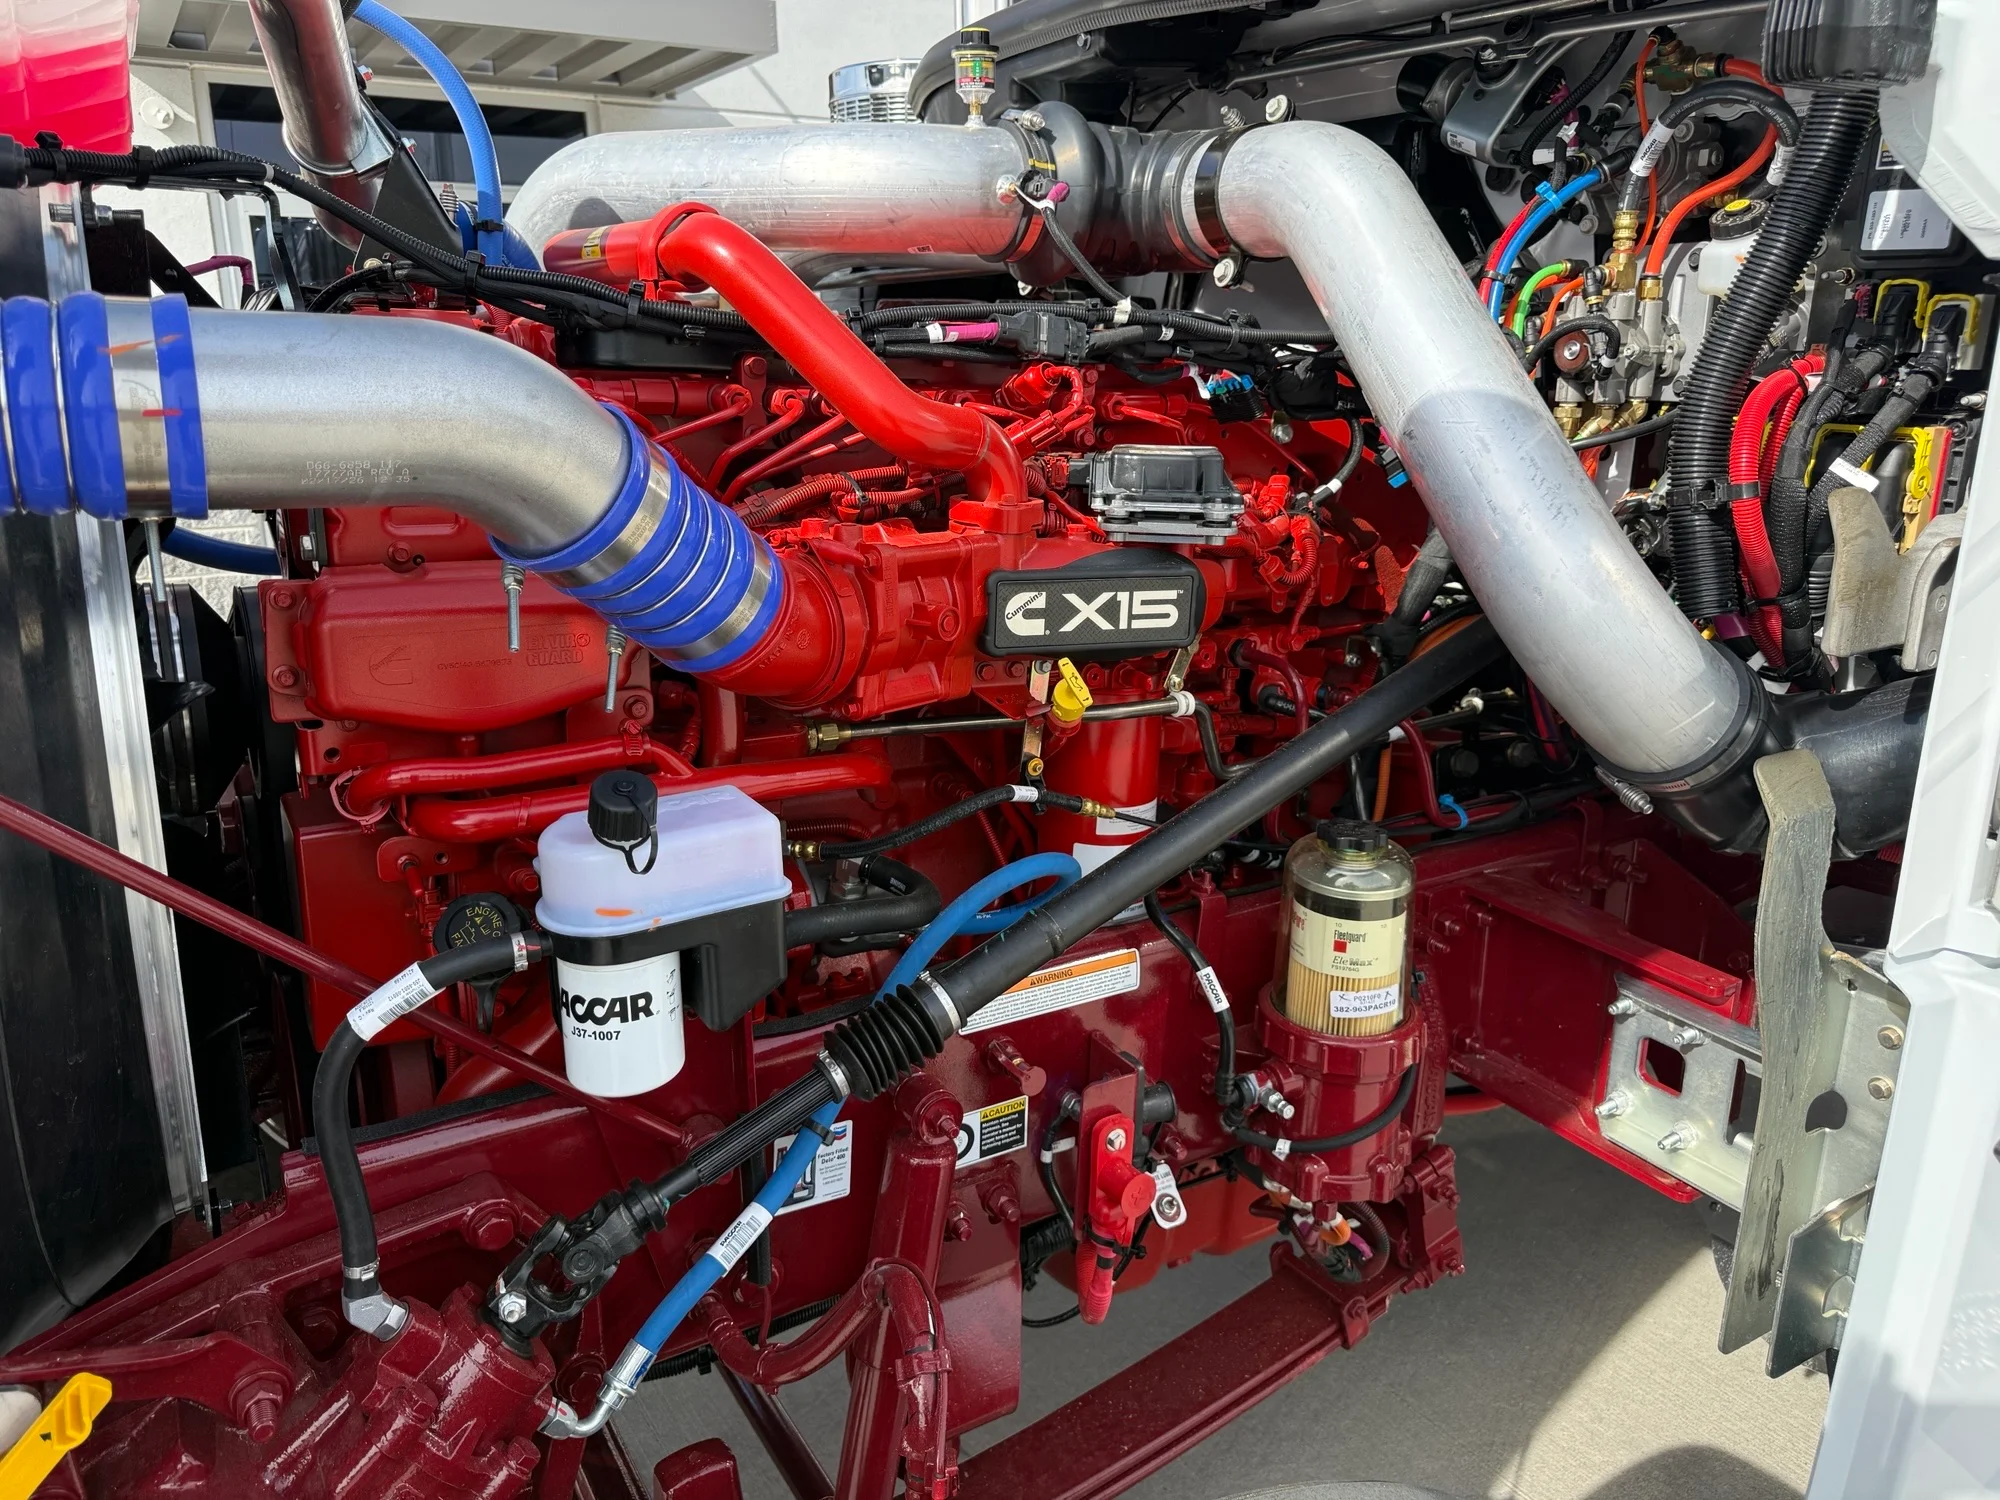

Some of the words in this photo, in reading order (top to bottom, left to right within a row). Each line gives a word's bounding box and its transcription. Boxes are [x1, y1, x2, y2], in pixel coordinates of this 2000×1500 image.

[1640, 138, 1657, 161] PACCAR
[1005, 591, 1044, 621] Cummins
[526, 649, 584, 667] GUARD
[466, 906, 502, 928] ENGINE
[1334, 930, 1367, 943] Fleetguard
[1035, 968, 1074, 985] WARNING
[1203, 972, 1223, 1005] PACCAR
[1353, 993, 1381, 1002] P0210F0
[560, 987, 655, 1026] ACCAR
[1333, 998, 1396, 1013] 382-963PACR10
[571, 1026, 622, 1041] J37-1007
[989, 1100, 1026, 1118] CAUTION
[817, 1150, 834, 1159] Factory
[720, 1220, 743, 1247] PACCAR
